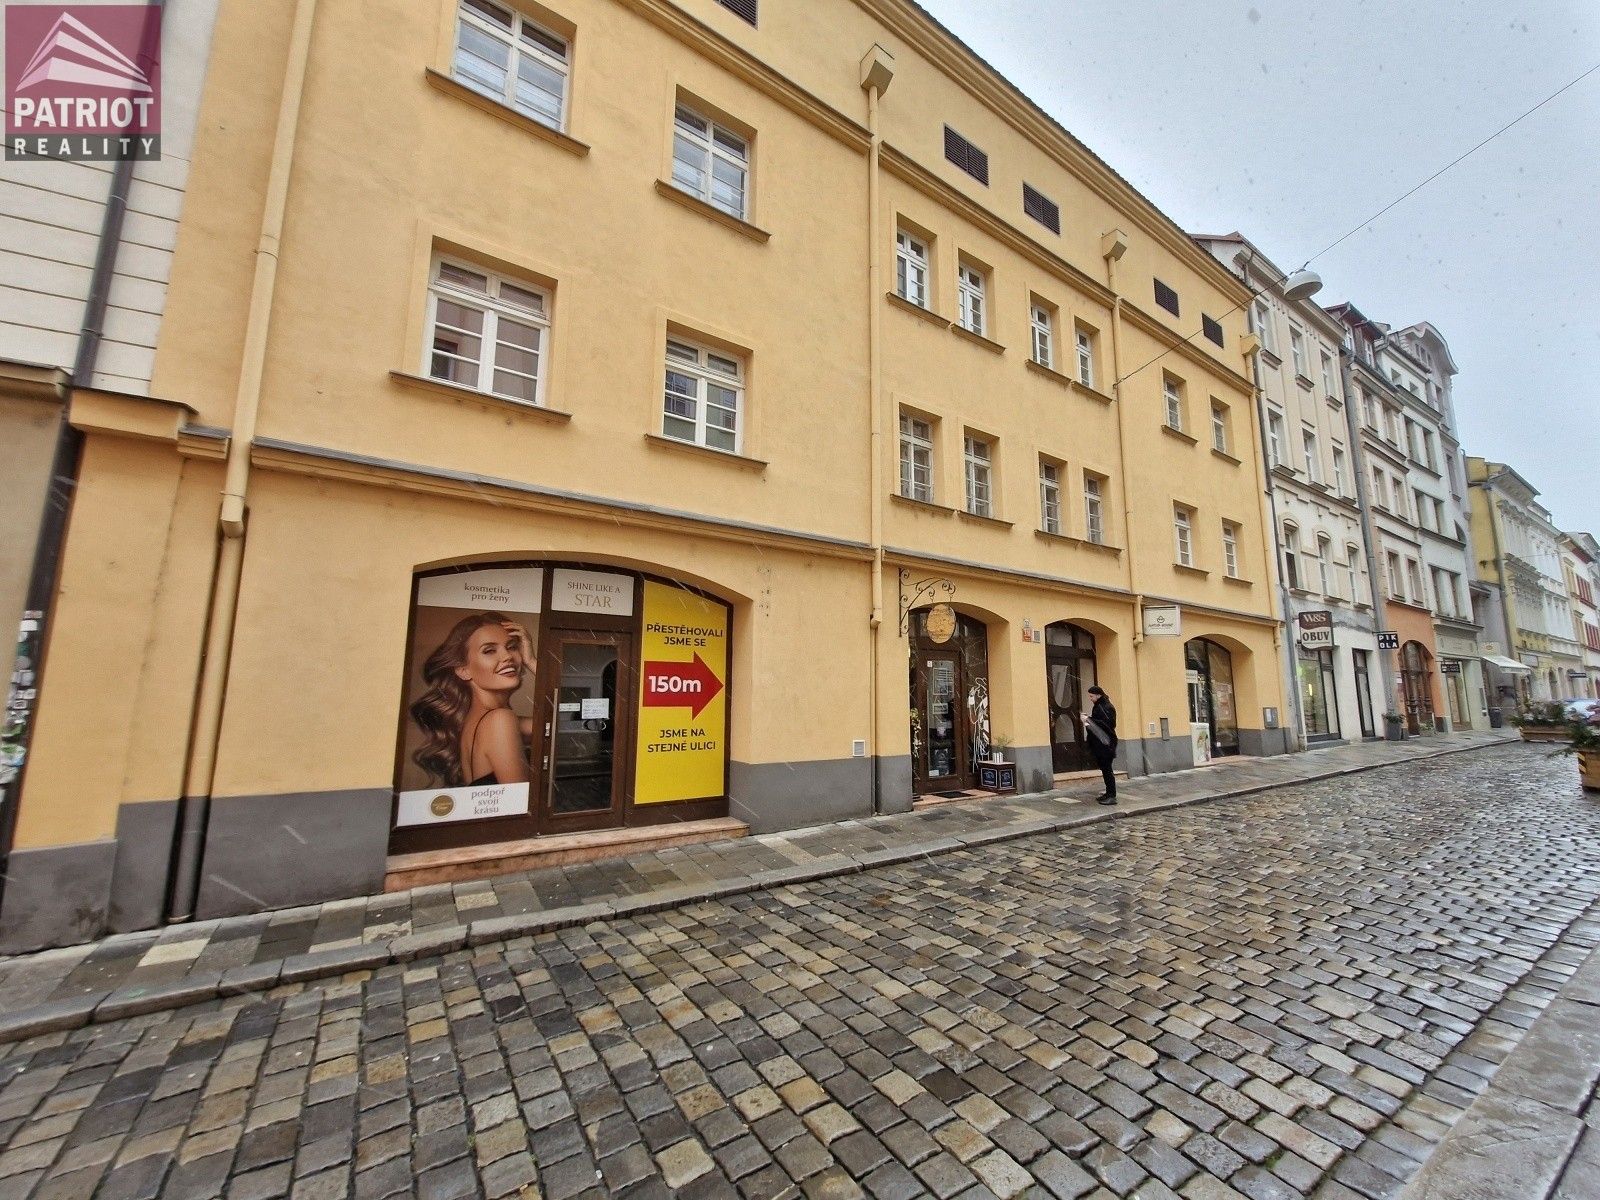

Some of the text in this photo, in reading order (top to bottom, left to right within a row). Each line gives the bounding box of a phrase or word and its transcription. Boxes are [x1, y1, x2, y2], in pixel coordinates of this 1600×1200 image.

[464, 582, 510, 595] kosmetika
[567, 581, 594, 591] SHINE
[595, 584, 613, 593] LIKE
[471, 593, 510, 603] pro ženy
[574, 593, 612, 608] STAR
[1303, 613, 1326, 623] W&S
[646, 623, 723, 638] PŘESTĚHOVALI
[1302, 631, 1330, 641] OBUV
[664, 636, 706, 647] JSME SE
[648, 675, 702, 693] 150m
[660, 728, 706, 738] JSME NA
[690, 741, 716, 750] ULICI
[471, 787, 506, 800] podpoř
